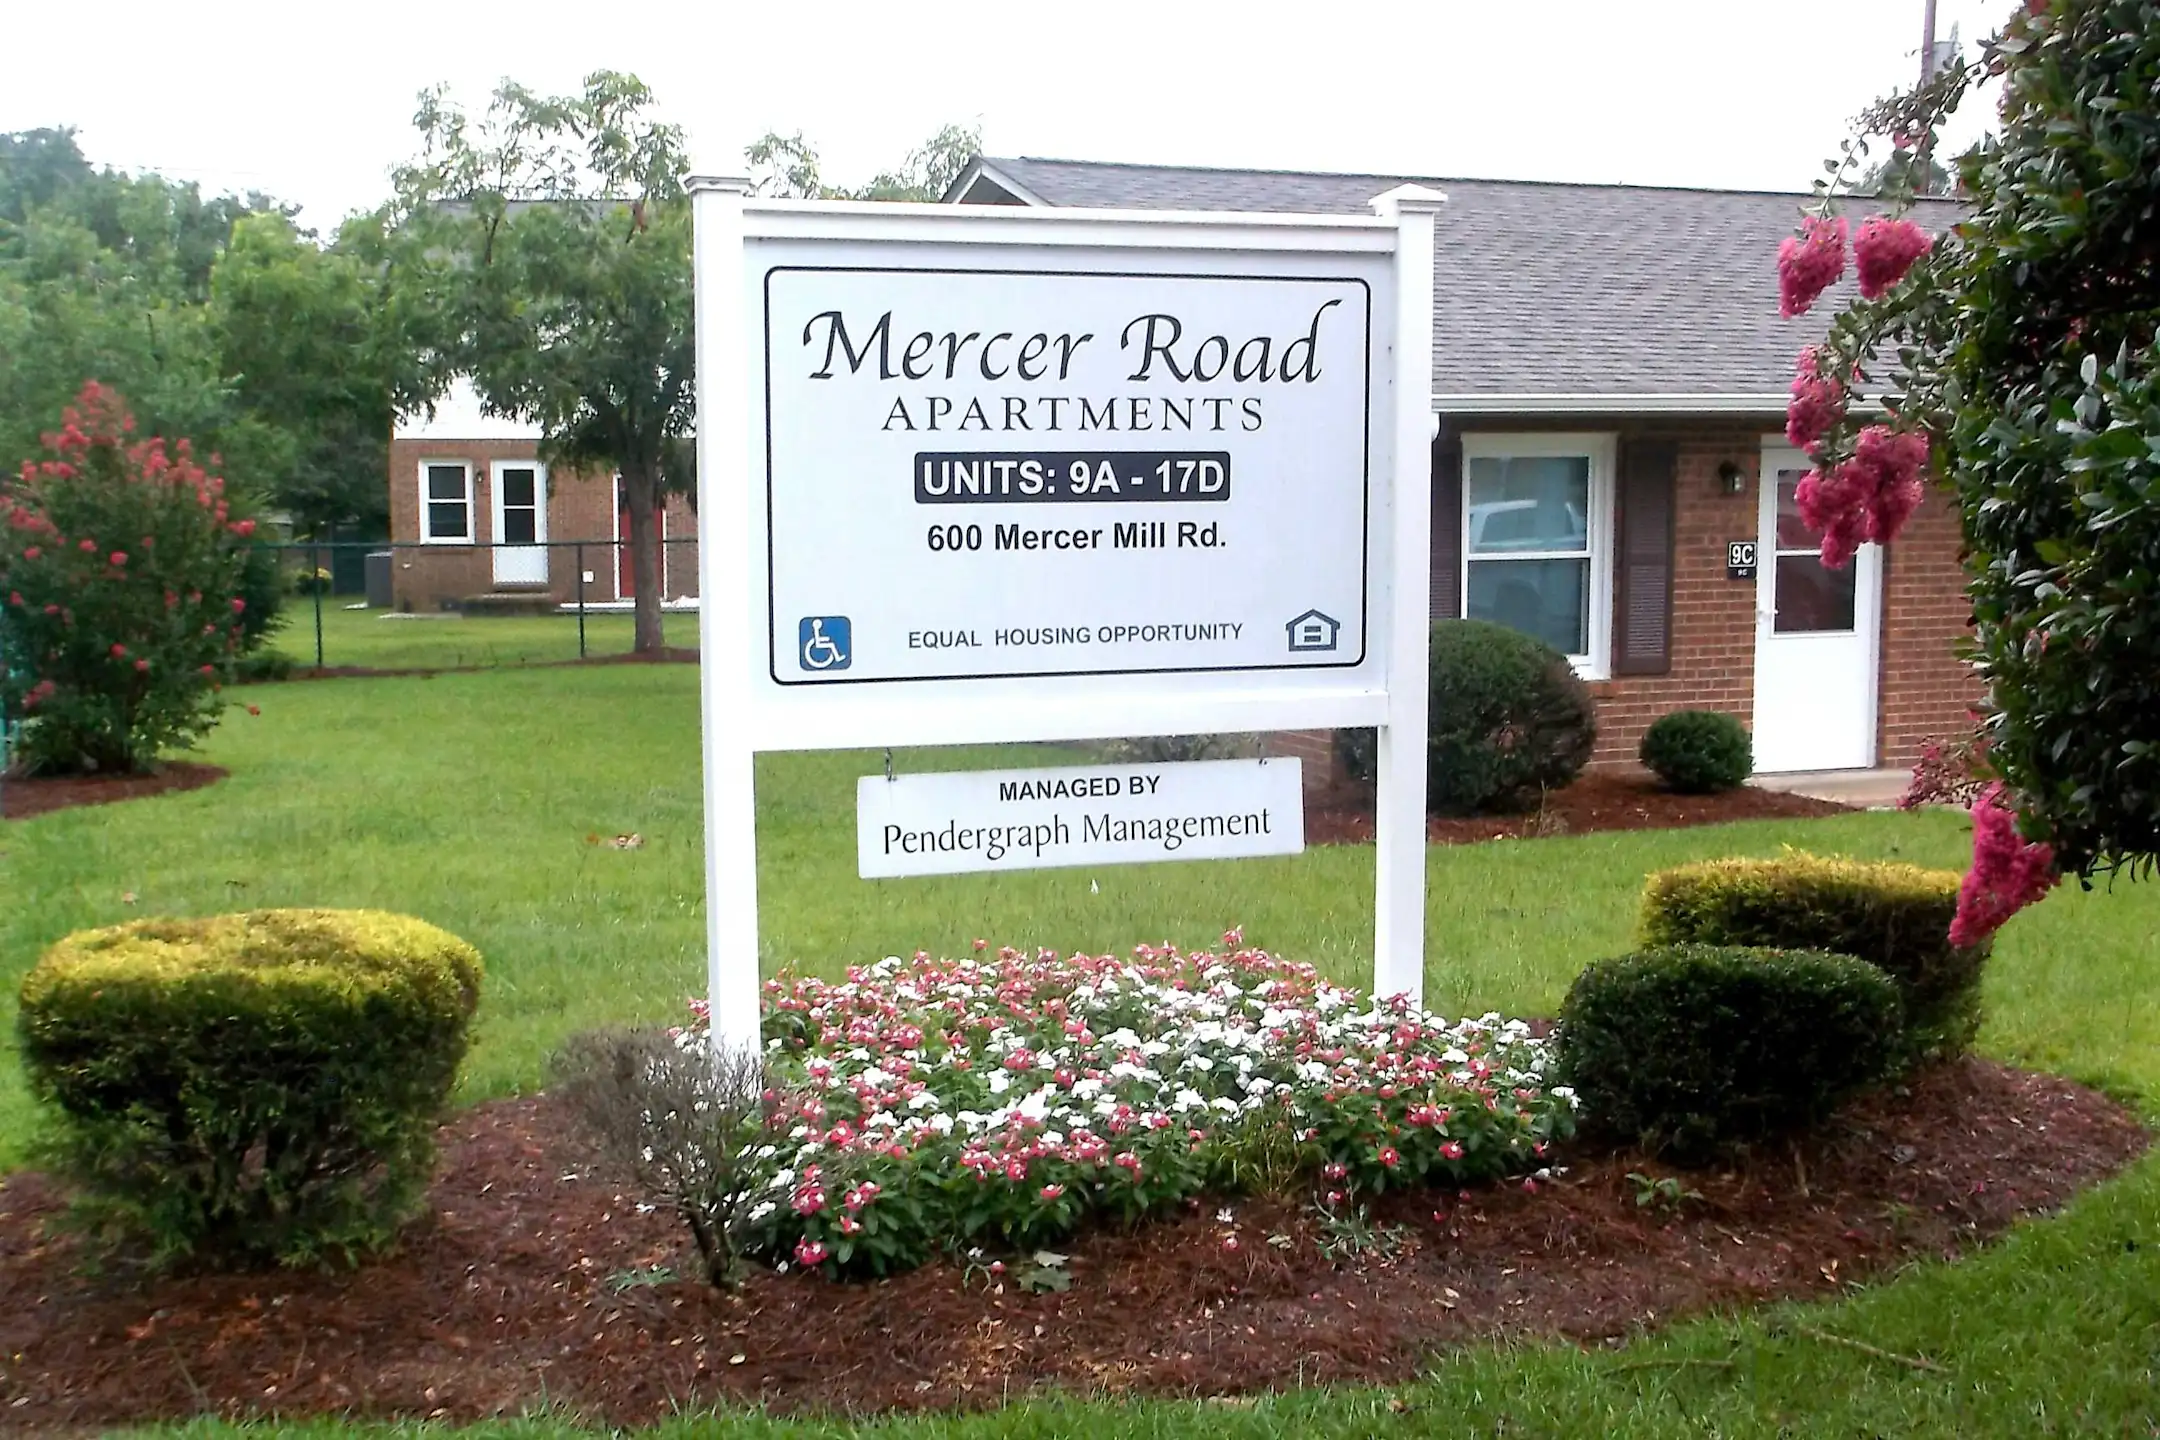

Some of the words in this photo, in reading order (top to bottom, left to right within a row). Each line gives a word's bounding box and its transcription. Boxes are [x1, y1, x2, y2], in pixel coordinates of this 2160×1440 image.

[802, 309, 1095, 382] Mercer
[1120, 299, 1343, 384] Road
[881, 396, 1264, 432] APARTMENTS
[922, 461, 1056, 496] UNITS:
[1068, 461, 1121, 495] 9A
[1155, 459, 1226, 494] 17D
[926, 524, 983, 553] 600
[994, 523, 1104, 552] Mercer
[1112, 521, 1166, 550] Mill
[1178, 521, 1228, 549] Rd.
[1732, 545, 1753, 564] 9C
[908, 629, 983, 650] EQUAL
[995, 626, 1092, 647] HOUSING
[1098, 623, 1244, 645] OPPORTUNITY
[999, 776, 1121, 802] MANAGED
[1129, 774, 1161, 797] BY
[883, 814, 1070, 861] Pendergraph
[1082, 806, 1272, 852] Management
